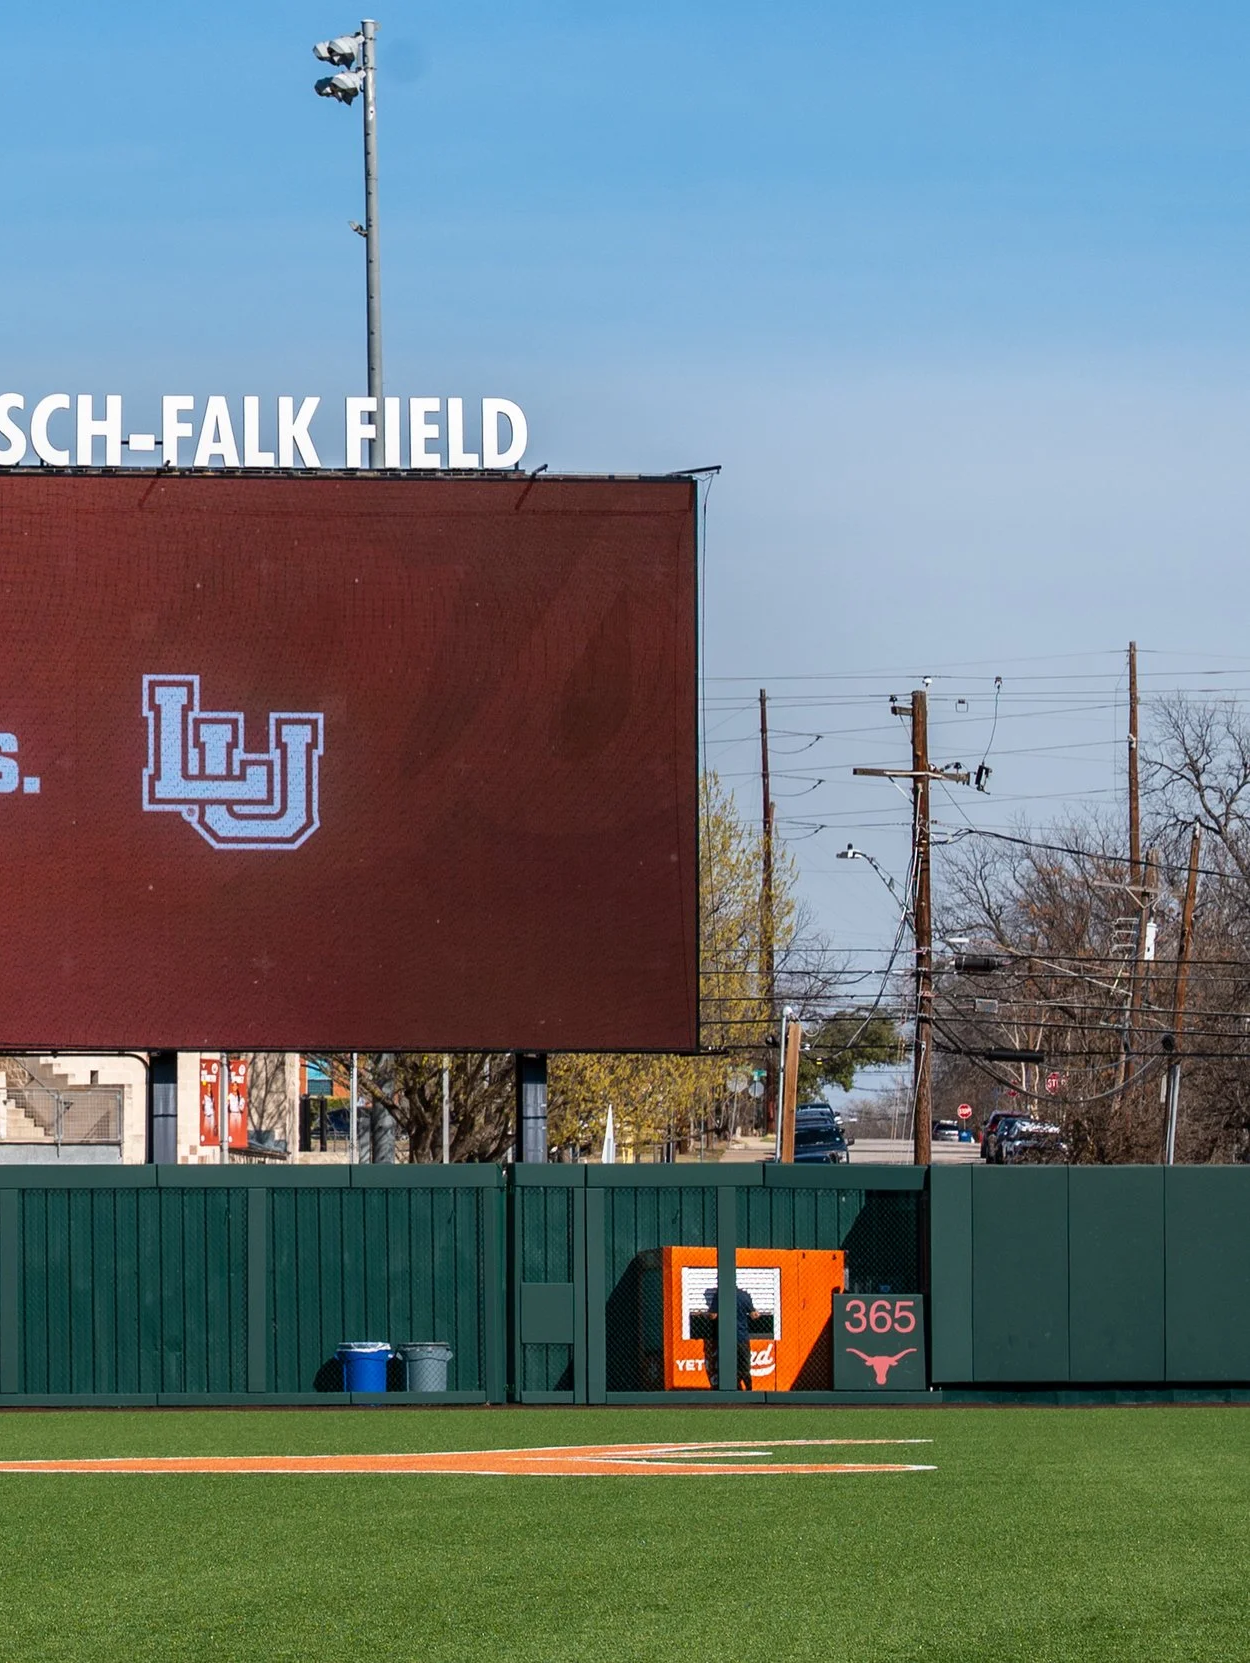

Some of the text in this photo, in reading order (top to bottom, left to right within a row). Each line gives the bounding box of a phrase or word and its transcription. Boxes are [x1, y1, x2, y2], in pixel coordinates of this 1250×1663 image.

[346, 397, 528, 469] FIELD
[845, 1300, 916, 1333] 365
[676, 1359, 705, 1372] YET
